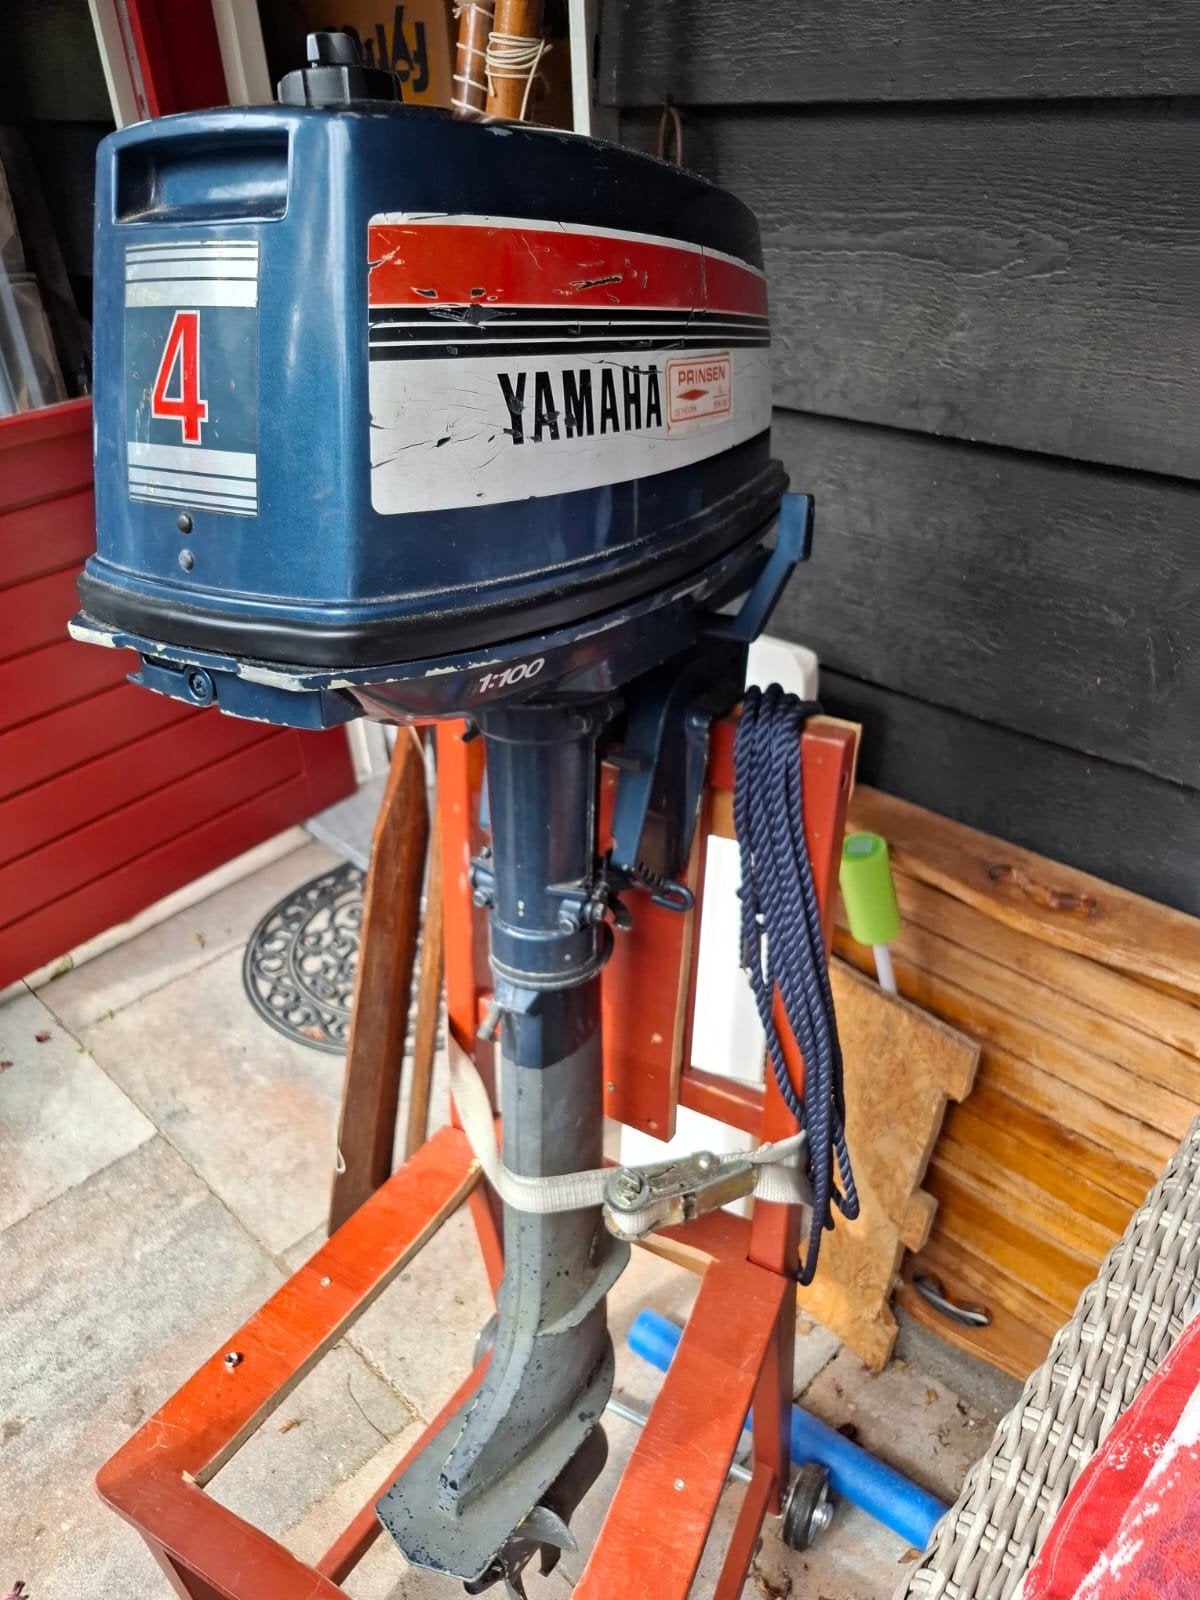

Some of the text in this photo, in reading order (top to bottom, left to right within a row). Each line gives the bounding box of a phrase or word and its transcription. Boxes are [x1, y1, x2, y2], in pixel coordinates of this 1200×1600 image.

[152, 310, 208, 445] 4
[678, 366, 725, 386] PRINSEN
[497, 365, 662, 445] YAMAHA
[480, 658, 545, 693] 1:100
